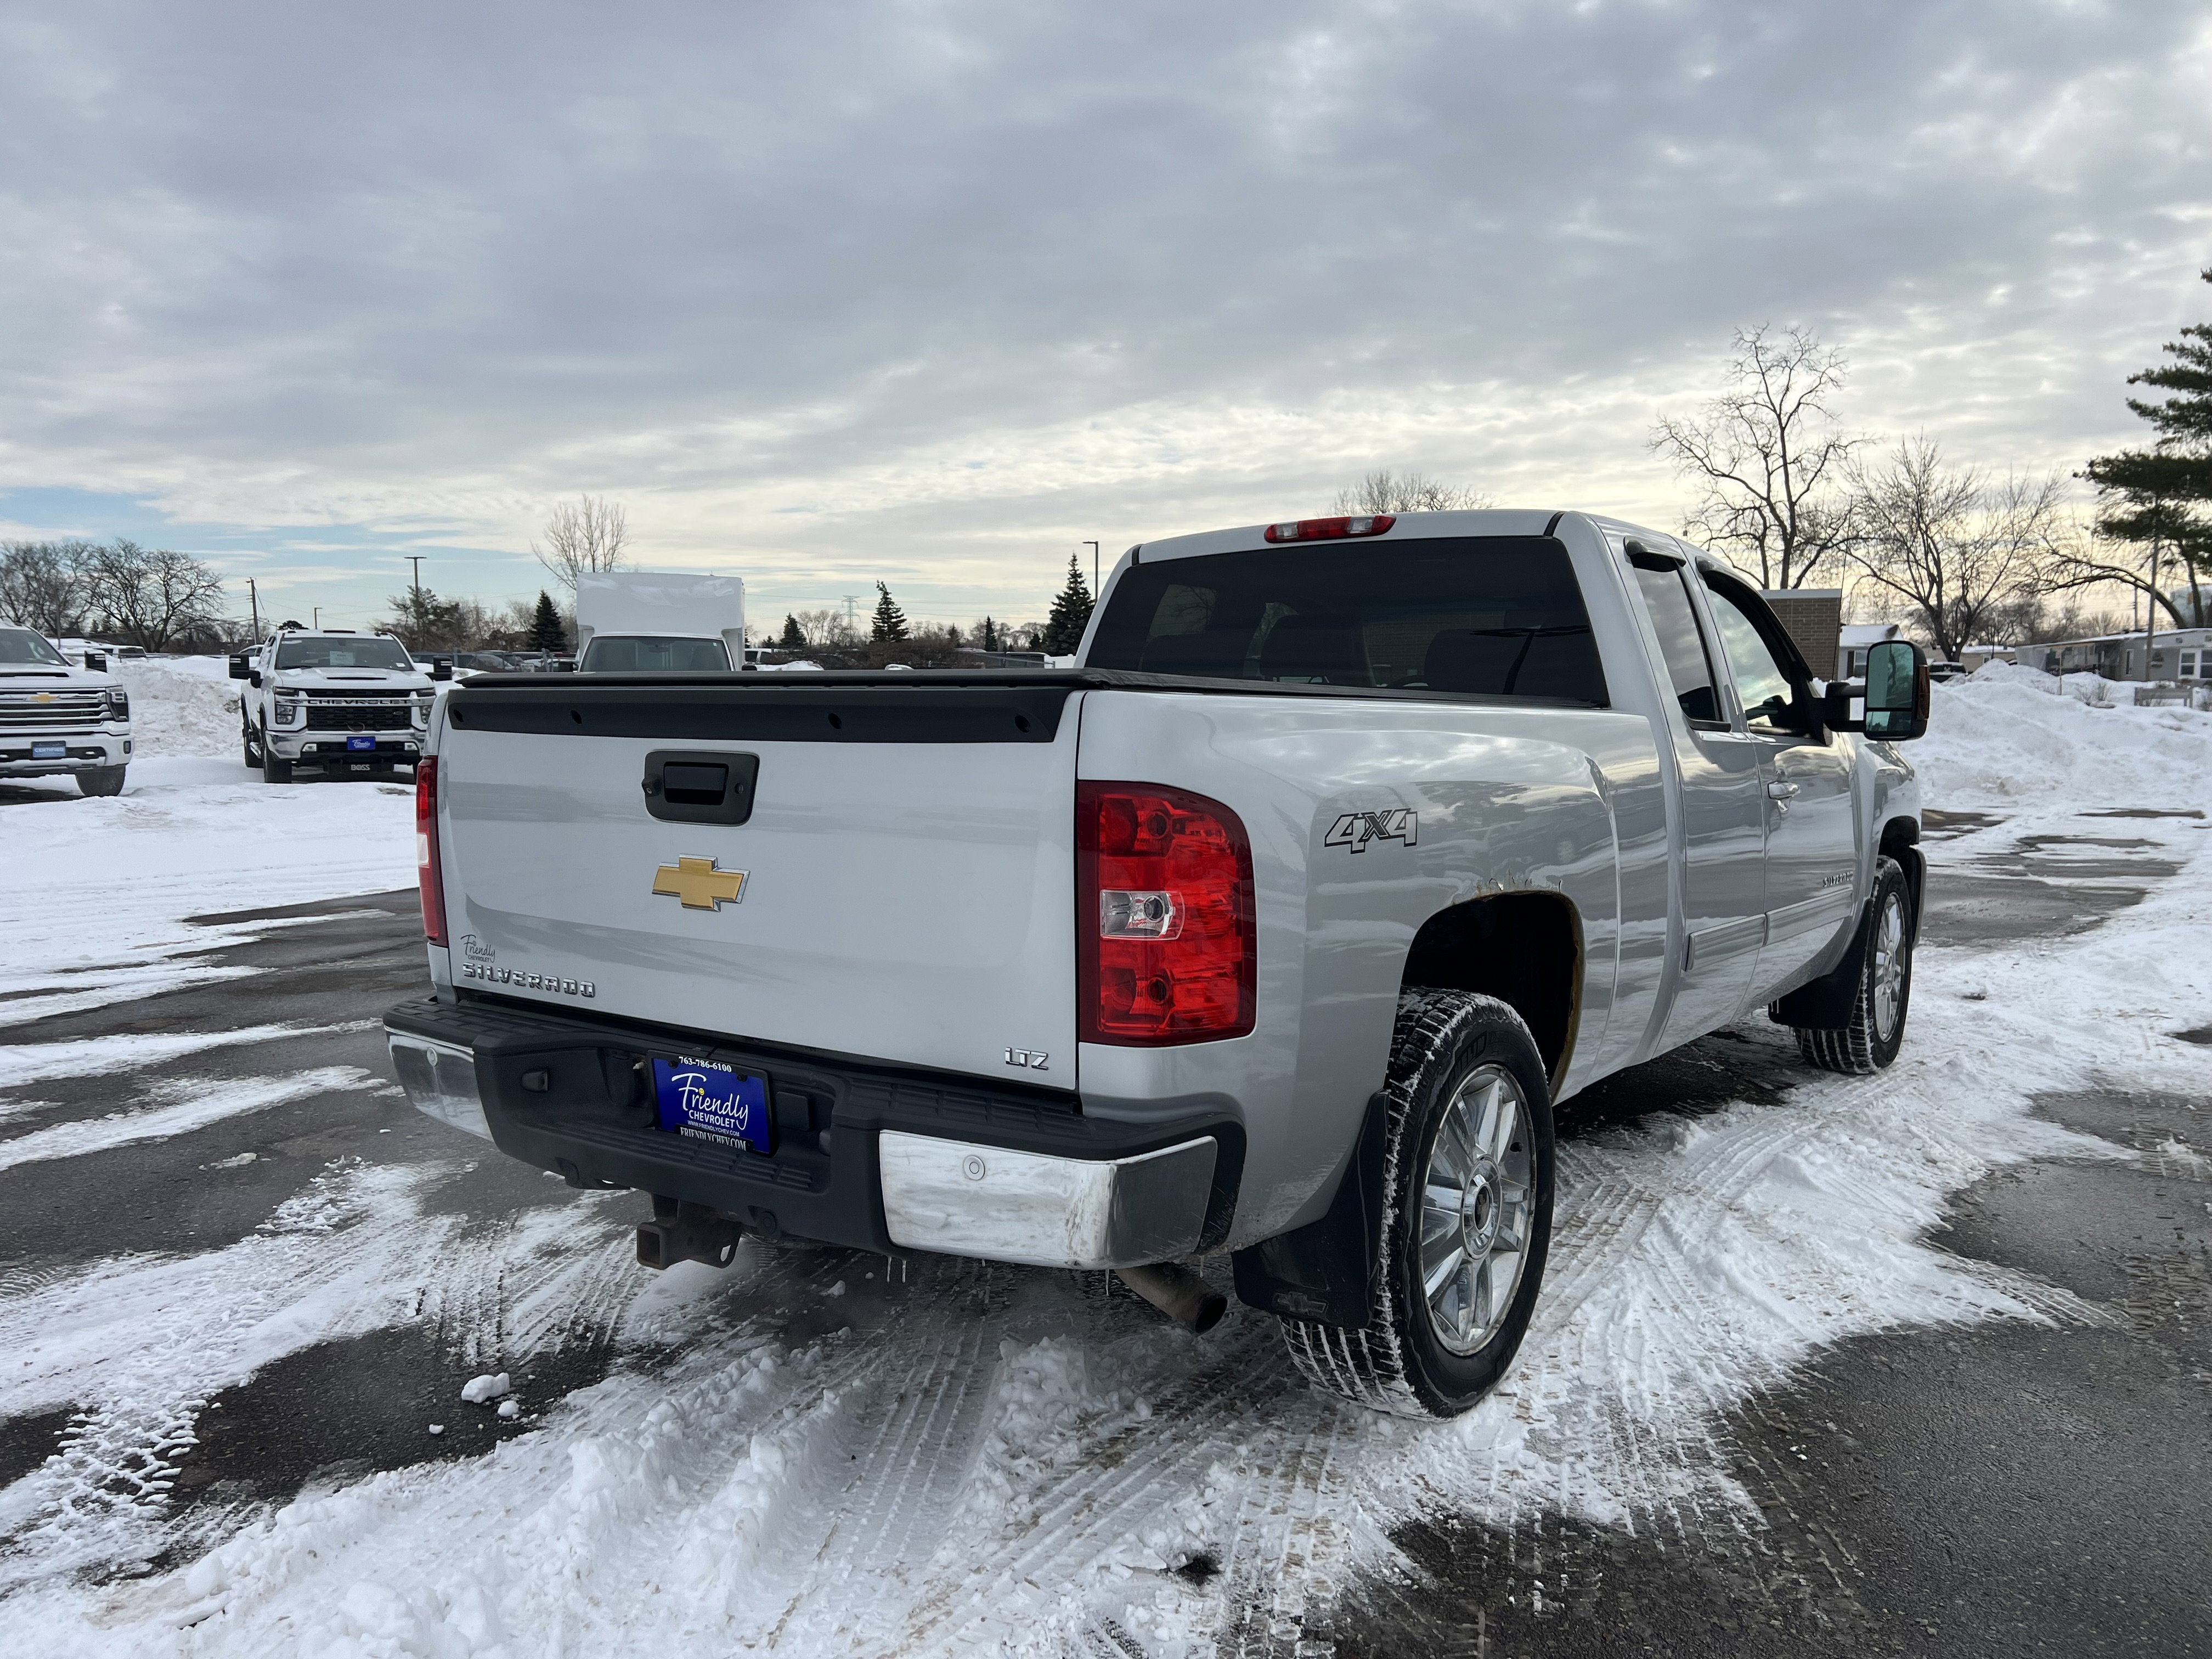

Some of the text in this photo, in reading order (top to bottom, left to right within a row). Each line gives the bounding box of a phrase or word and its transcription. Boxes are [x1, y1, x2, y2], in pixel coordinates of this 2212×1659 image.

[460, 934, 495, 963] Friendly
[462, 962, 595, 997] SILVERADO
[679, 1056, 732, 1073] 763-786-6100
[1005, 1047, 1048, 1070] LTZ
[672, 1073, 748, 1130] Friendly
[689, 1110, 735, 1128] CHEVROLET
[680, 1127, 746, 1151] FRIENDLYCHEV.COM
